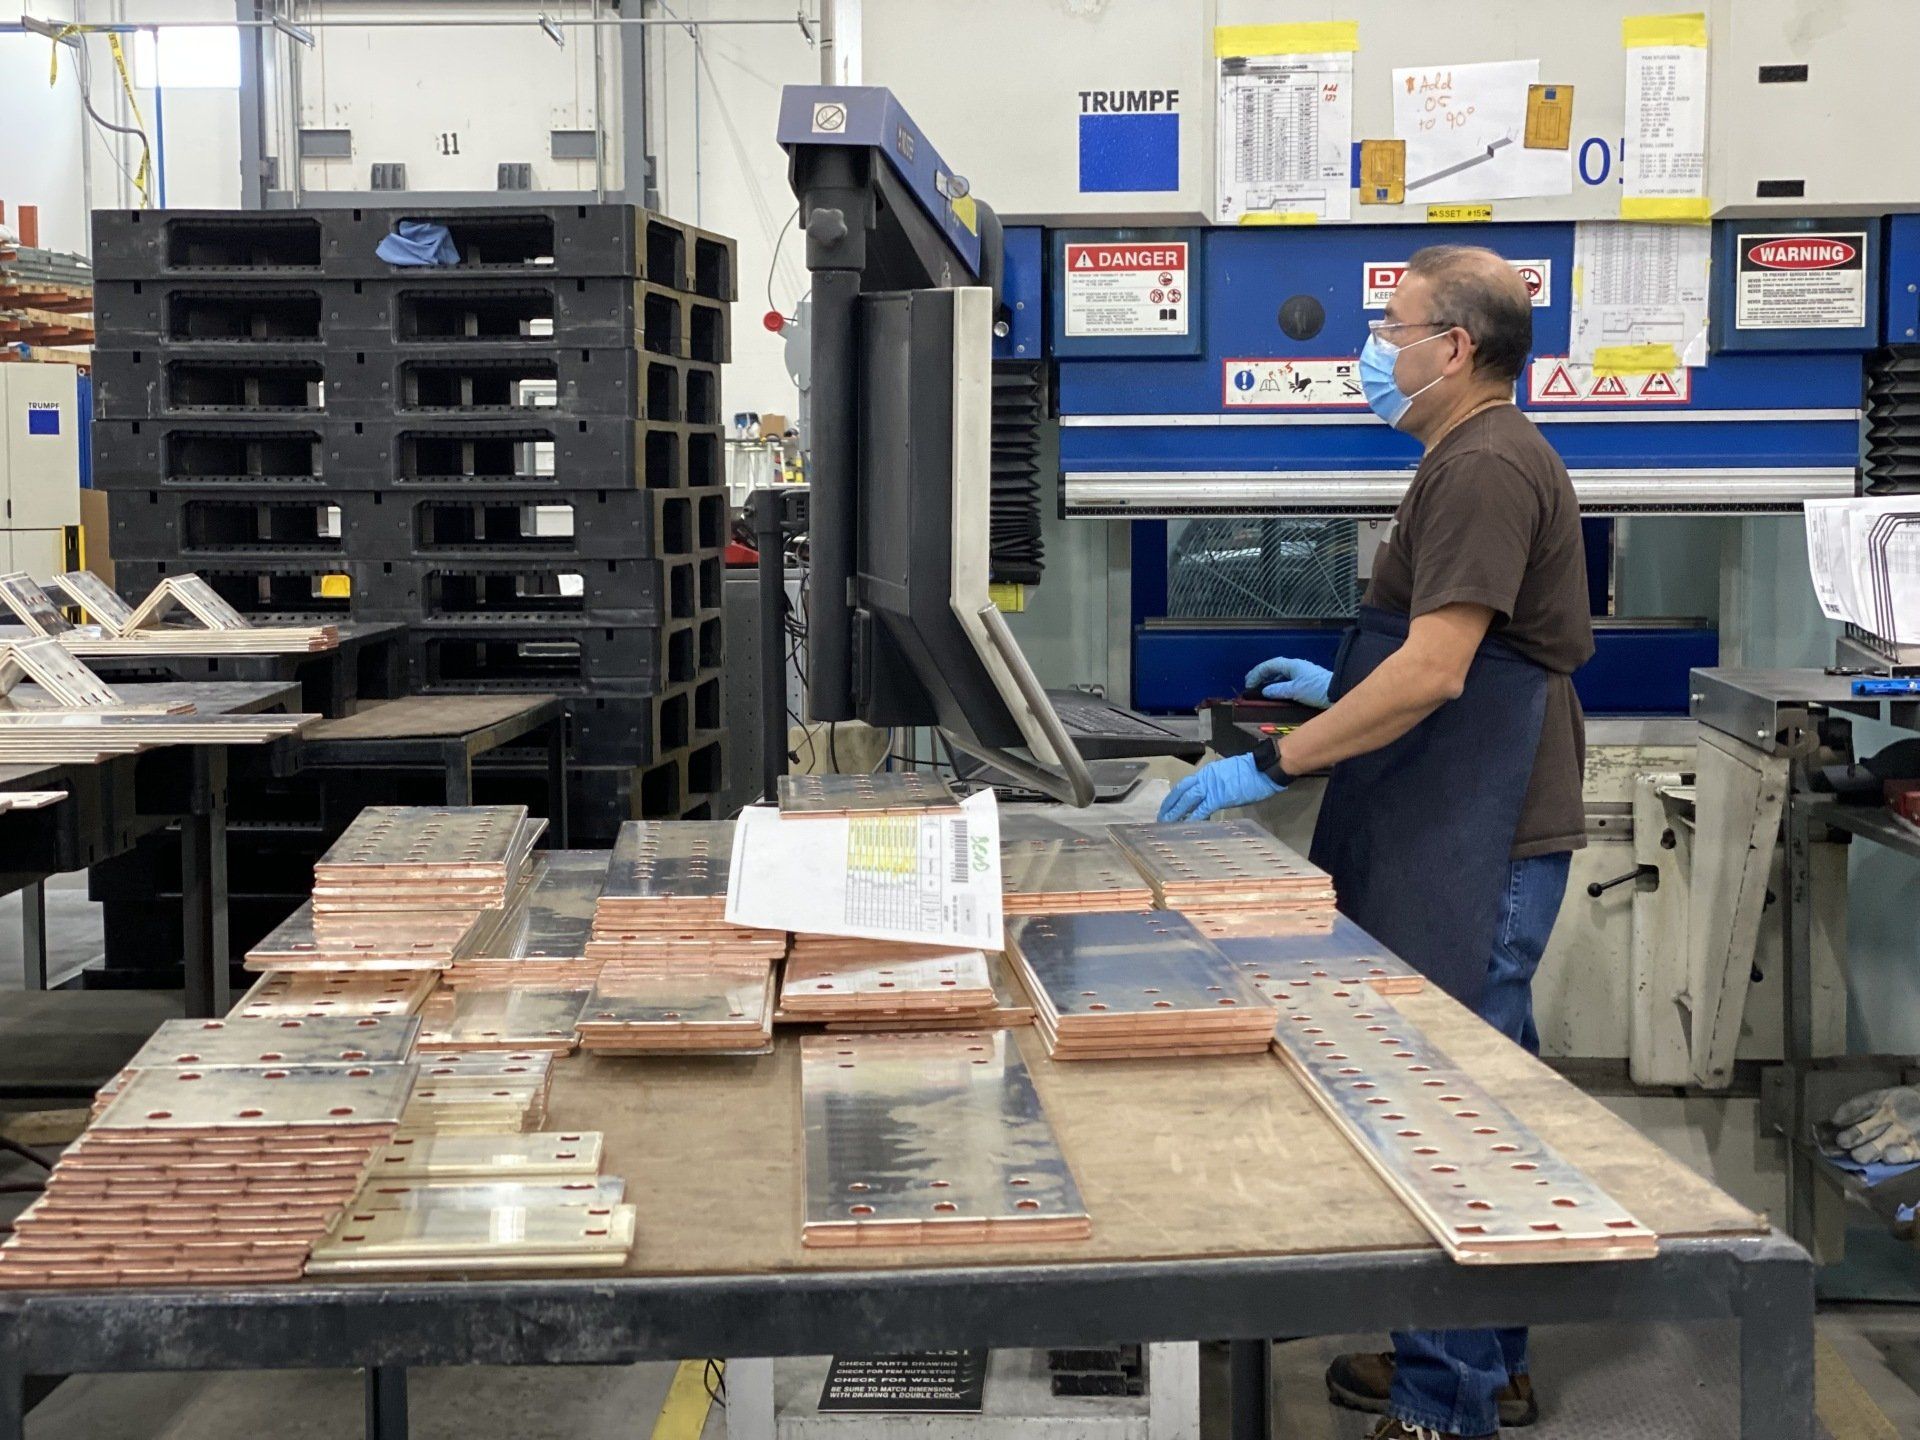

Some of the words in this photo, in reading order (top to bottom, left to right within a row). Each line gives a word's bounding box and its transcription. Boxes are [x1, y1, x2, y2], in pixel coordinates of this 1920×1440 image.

[1420, 72, 1452, 93] Add
[1078, 90, 1179, 112] TRUMPF
[442, 133, 460, 155] 11
[1579, 138, 1624, 185] 0
[1099, 251, 1177, 266] DANGER
[1760, 246, 1844, 262] WARNING
